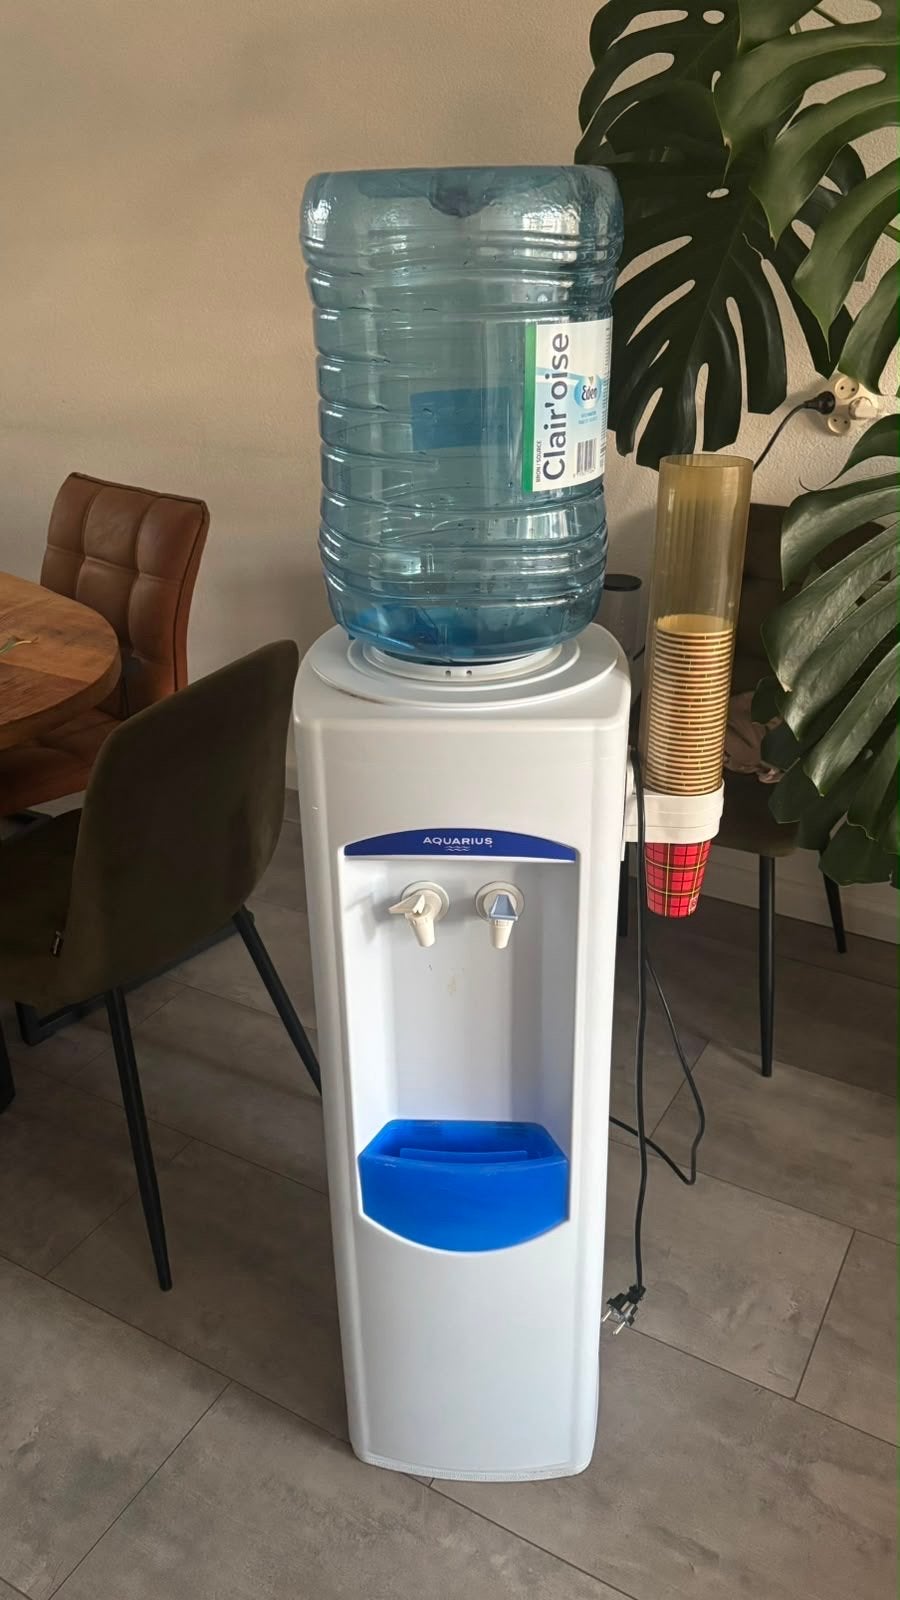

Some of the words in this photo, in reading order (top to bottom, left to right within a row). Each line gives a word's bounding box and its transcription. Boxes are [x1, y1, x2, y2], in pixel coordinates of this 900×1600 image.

[581, 385, 598, 401] Eden
[543, 333, 569, 480] Clair'oise
[423, 836, 493, 845] AQUARIUS
